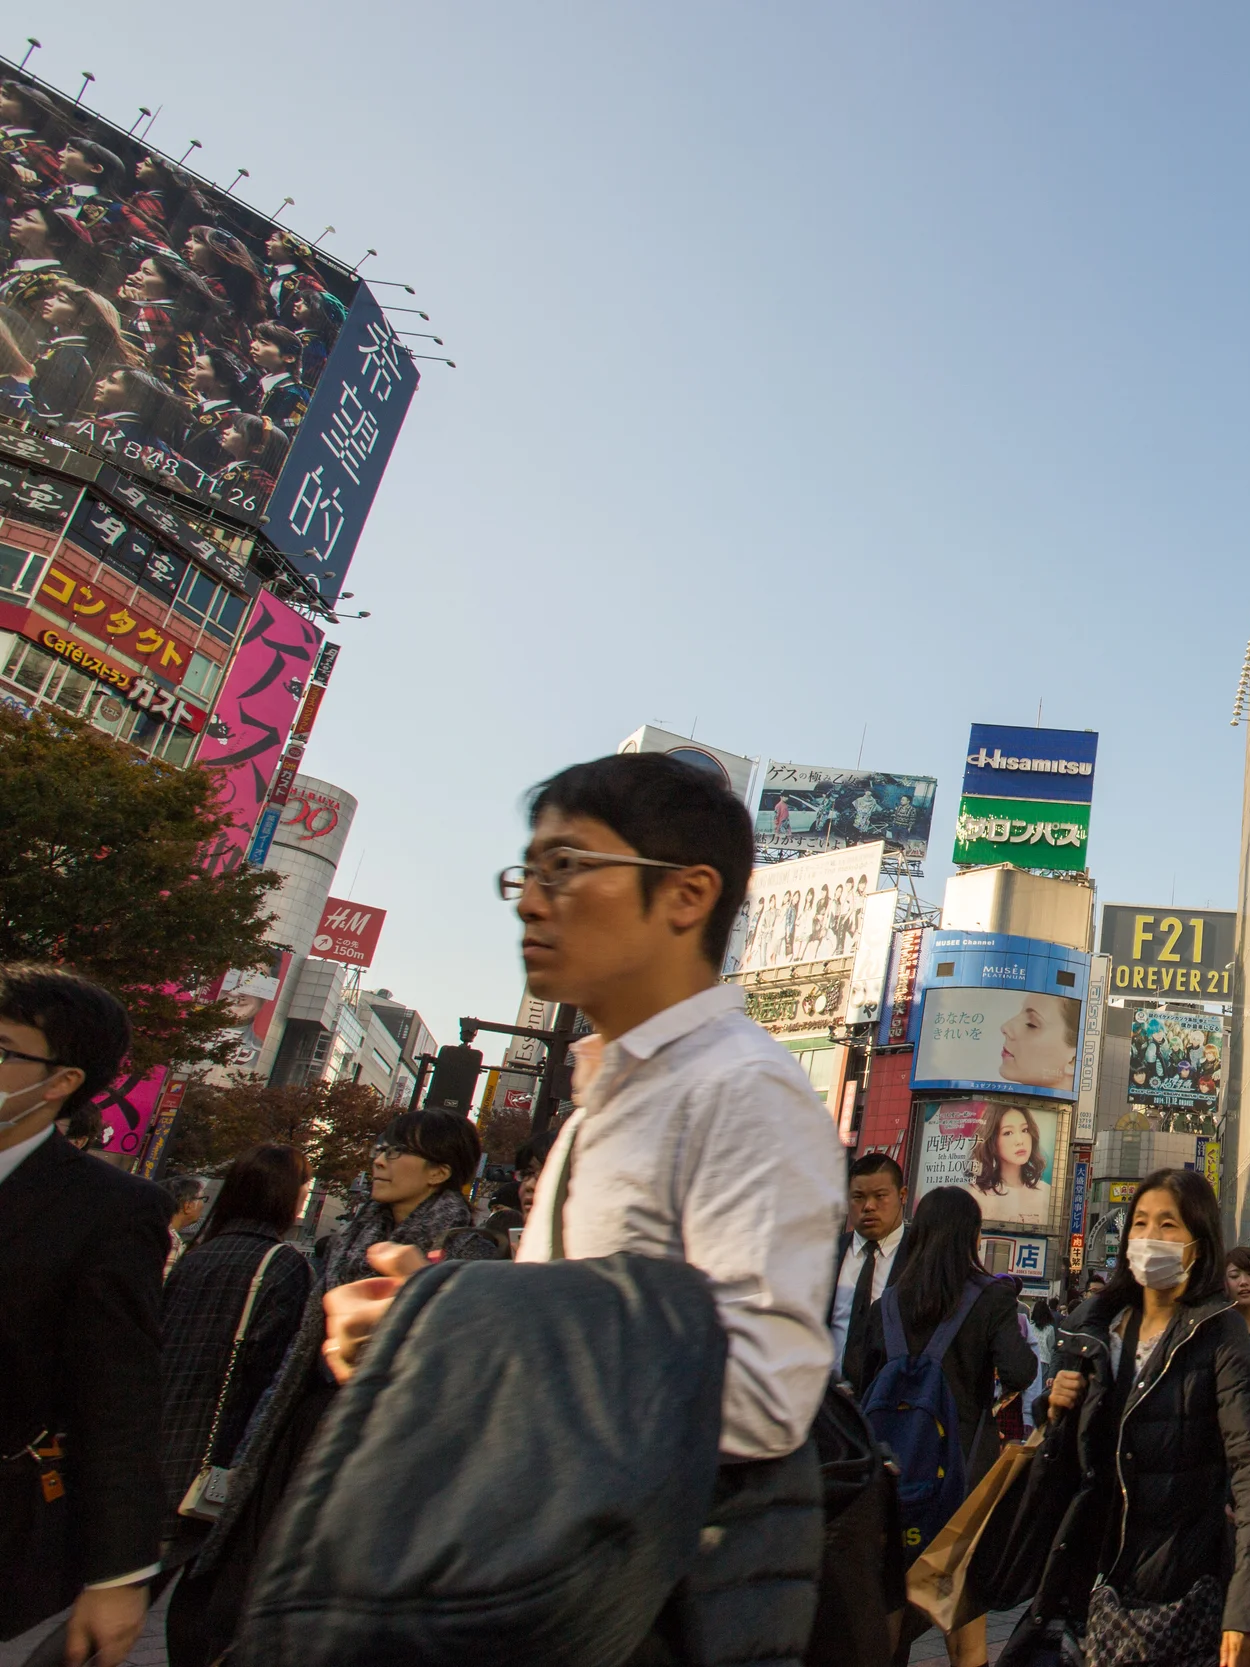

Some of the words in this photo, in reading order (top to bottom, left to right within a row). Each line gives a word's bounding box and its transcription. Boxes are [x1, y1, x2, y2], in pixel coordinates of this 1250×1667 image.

[0, 389, 63, 418] イン
[76, 421, 180, 477] AKB48
[228, 488, 256, 511] 26
[98, 502, 113, 514] 9F
[117, 486, 178, 534] 月の宴
[91, 516, 175, 582] 月の宴
[190, 539, 245, 583] 月の宴
[41, 567, 183, 667] コンタクト
[102, 705, 119, 718] ガスト
[128, 676, 193, 725] ガスト
[767, 764, 860, 786] ゲスの極み乙女
[966, 747, 1093, 776] Hisamitsu
[275, 768, 293, 798] ガスト
[289, 787, 340, 811] HIBUYA
[280, 797, 338, 841] 09
[964, 816, 1081, 848] サロンパス
[324, 906, 372, 936] H&M
[333, 945, 365, 960] 150m
[335, 937, 359, 949] この先
[935, 939, 961, 947] MUSEE
[962, 939, 995, 947] Channel
[1133, 915, 1205, 964] F21
[1116, 966, 1201, 992] OREVER
[1207, 970, 1230, 994] 21
[933, 1011, 985, 1025] あなたの
[932, 1027, 982, 1041] きれいを
[1081, 1040, 1099, 1092] neon
[970, 1082, 1014, 1091] ミュゼプラチナム
[926, 1134, 984, 1153] 西野カナ
[925, 1161, 946, 1173] with
[948, 1160, 980, 1173] LOVE
[925, 1176, 943, 1184] 11.12
[1072, 1167, 1085, 1230] 大盛堂商事ビル
[1016, 1244, 1040, 1268] 店
